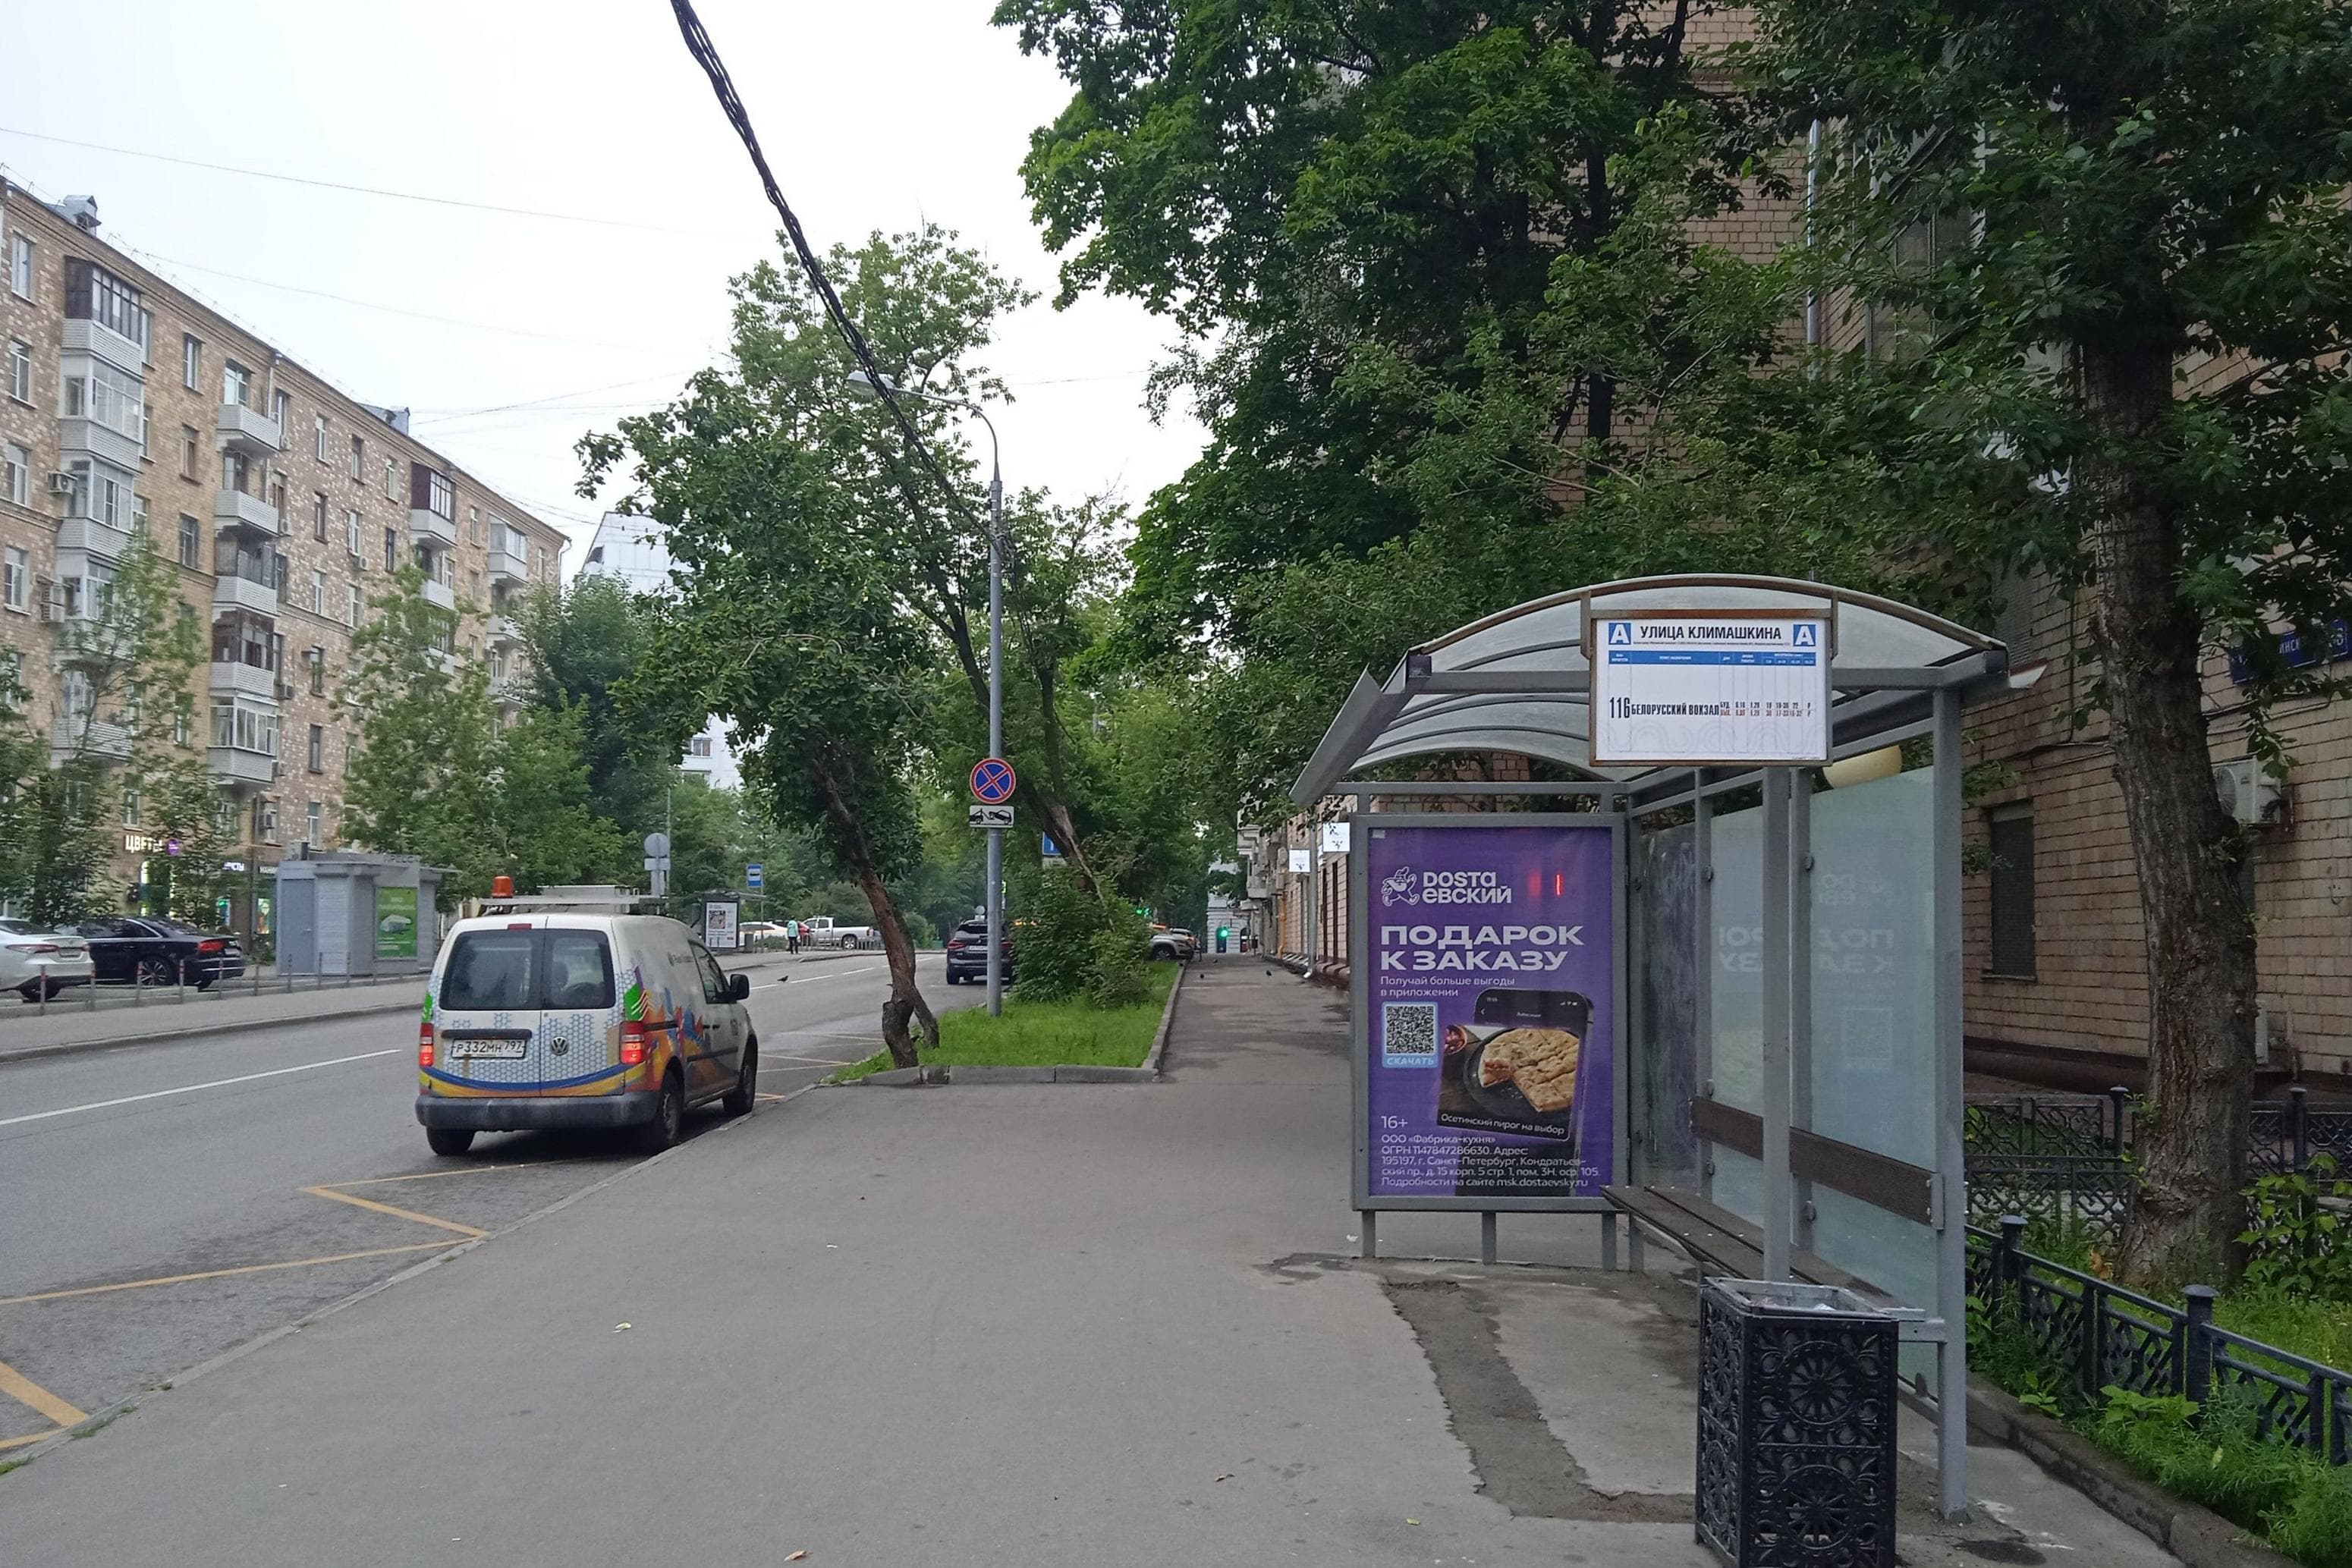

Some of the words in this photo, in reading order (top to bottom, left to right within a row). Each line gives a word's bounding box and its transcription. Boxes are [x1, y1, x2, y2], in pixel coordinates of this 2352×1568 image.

[1610, 624, 1630, 644] А
[1640, 626, 1684, 640] УЛИЦА
[1688, 626, 1781, 639] КЛИМАШКИНА
[1794, 625, 1815, 646] А
[1609, 696, 1630, 718] 116
[1631, 702, 1687, 715] БЕЛОРУССКИЙ
[1688, 704, 1719, 715] ВОКЗАЛ
[1381, 925, 1584, 950] ПОДАРОК
[1381, 951, 1407, 971] К
[1413, 951, 1569, 971] ЗАКАЗУ
[1381, 976, 1428, 987] Получай
[1430, 976, 1471, 985] больше
[1473, 978, 1514, 987] выгоды
[1390, 988, 1458, 999] приложении
[504, 1041, 522, 1050] 797
[1387, 1057, 1435, 1066] СКАЧАТЬ
[1381, 1116, 1408, 1129] 16+
[1441, 1113, 1493, 1127] Осетинский
[1494, 1121, 1520, 1130] пирог
[1534, 1125, 1564, 1136] выбор
[1381, 1134, 1407, 1143] ООО
[1381, 1145, 1411, 1155] ОГРН
[1494, 1146, 1529, 1156] Адрес:
[1381, 1167, 1405, 1176] ский
[1437, 1167, 1448, 1176] 15
[1478, 1167, 1485, 1176] 5
[1382, 1177, 1450, 1187] Подробности
[1465, 1177, 1495, 1186] сайте
[1496, 1177, 1589, 1187] msk.dostaevsky.ru
